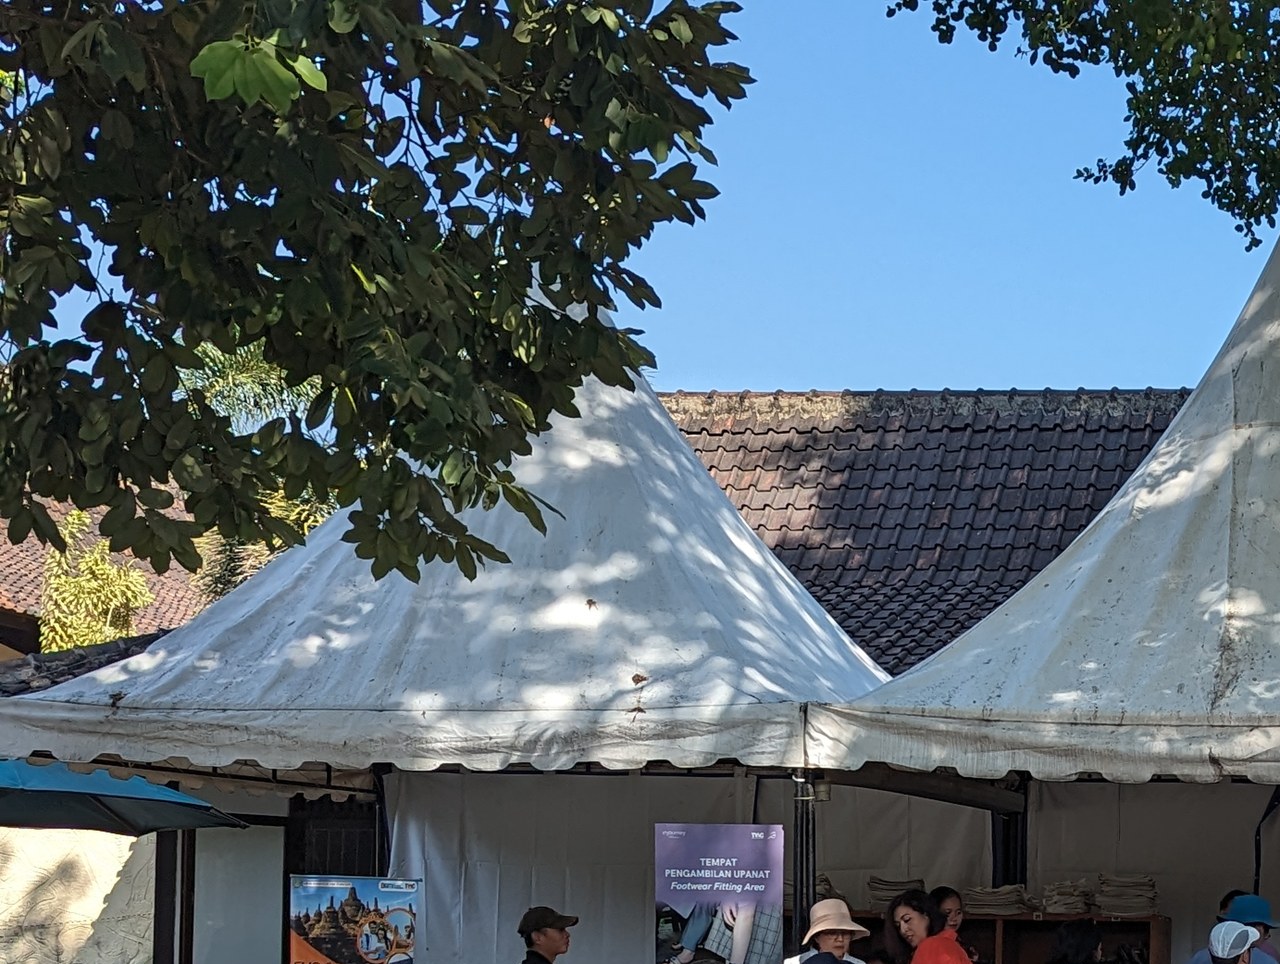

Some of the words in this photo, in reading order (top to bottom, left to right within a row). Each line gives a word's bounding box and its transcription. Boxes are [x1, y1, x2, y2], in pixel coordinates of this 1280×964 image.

[699, 858, 738, 867] TEMPAT
[664, 869, 732, 878] PENGAMBILAN
[733, 870, 771, 879] UPANAT
[670, 882, 712, 890] Footwear
[713, 882, 743, 893] Fitting
[744, 883, 765, 891] Area
